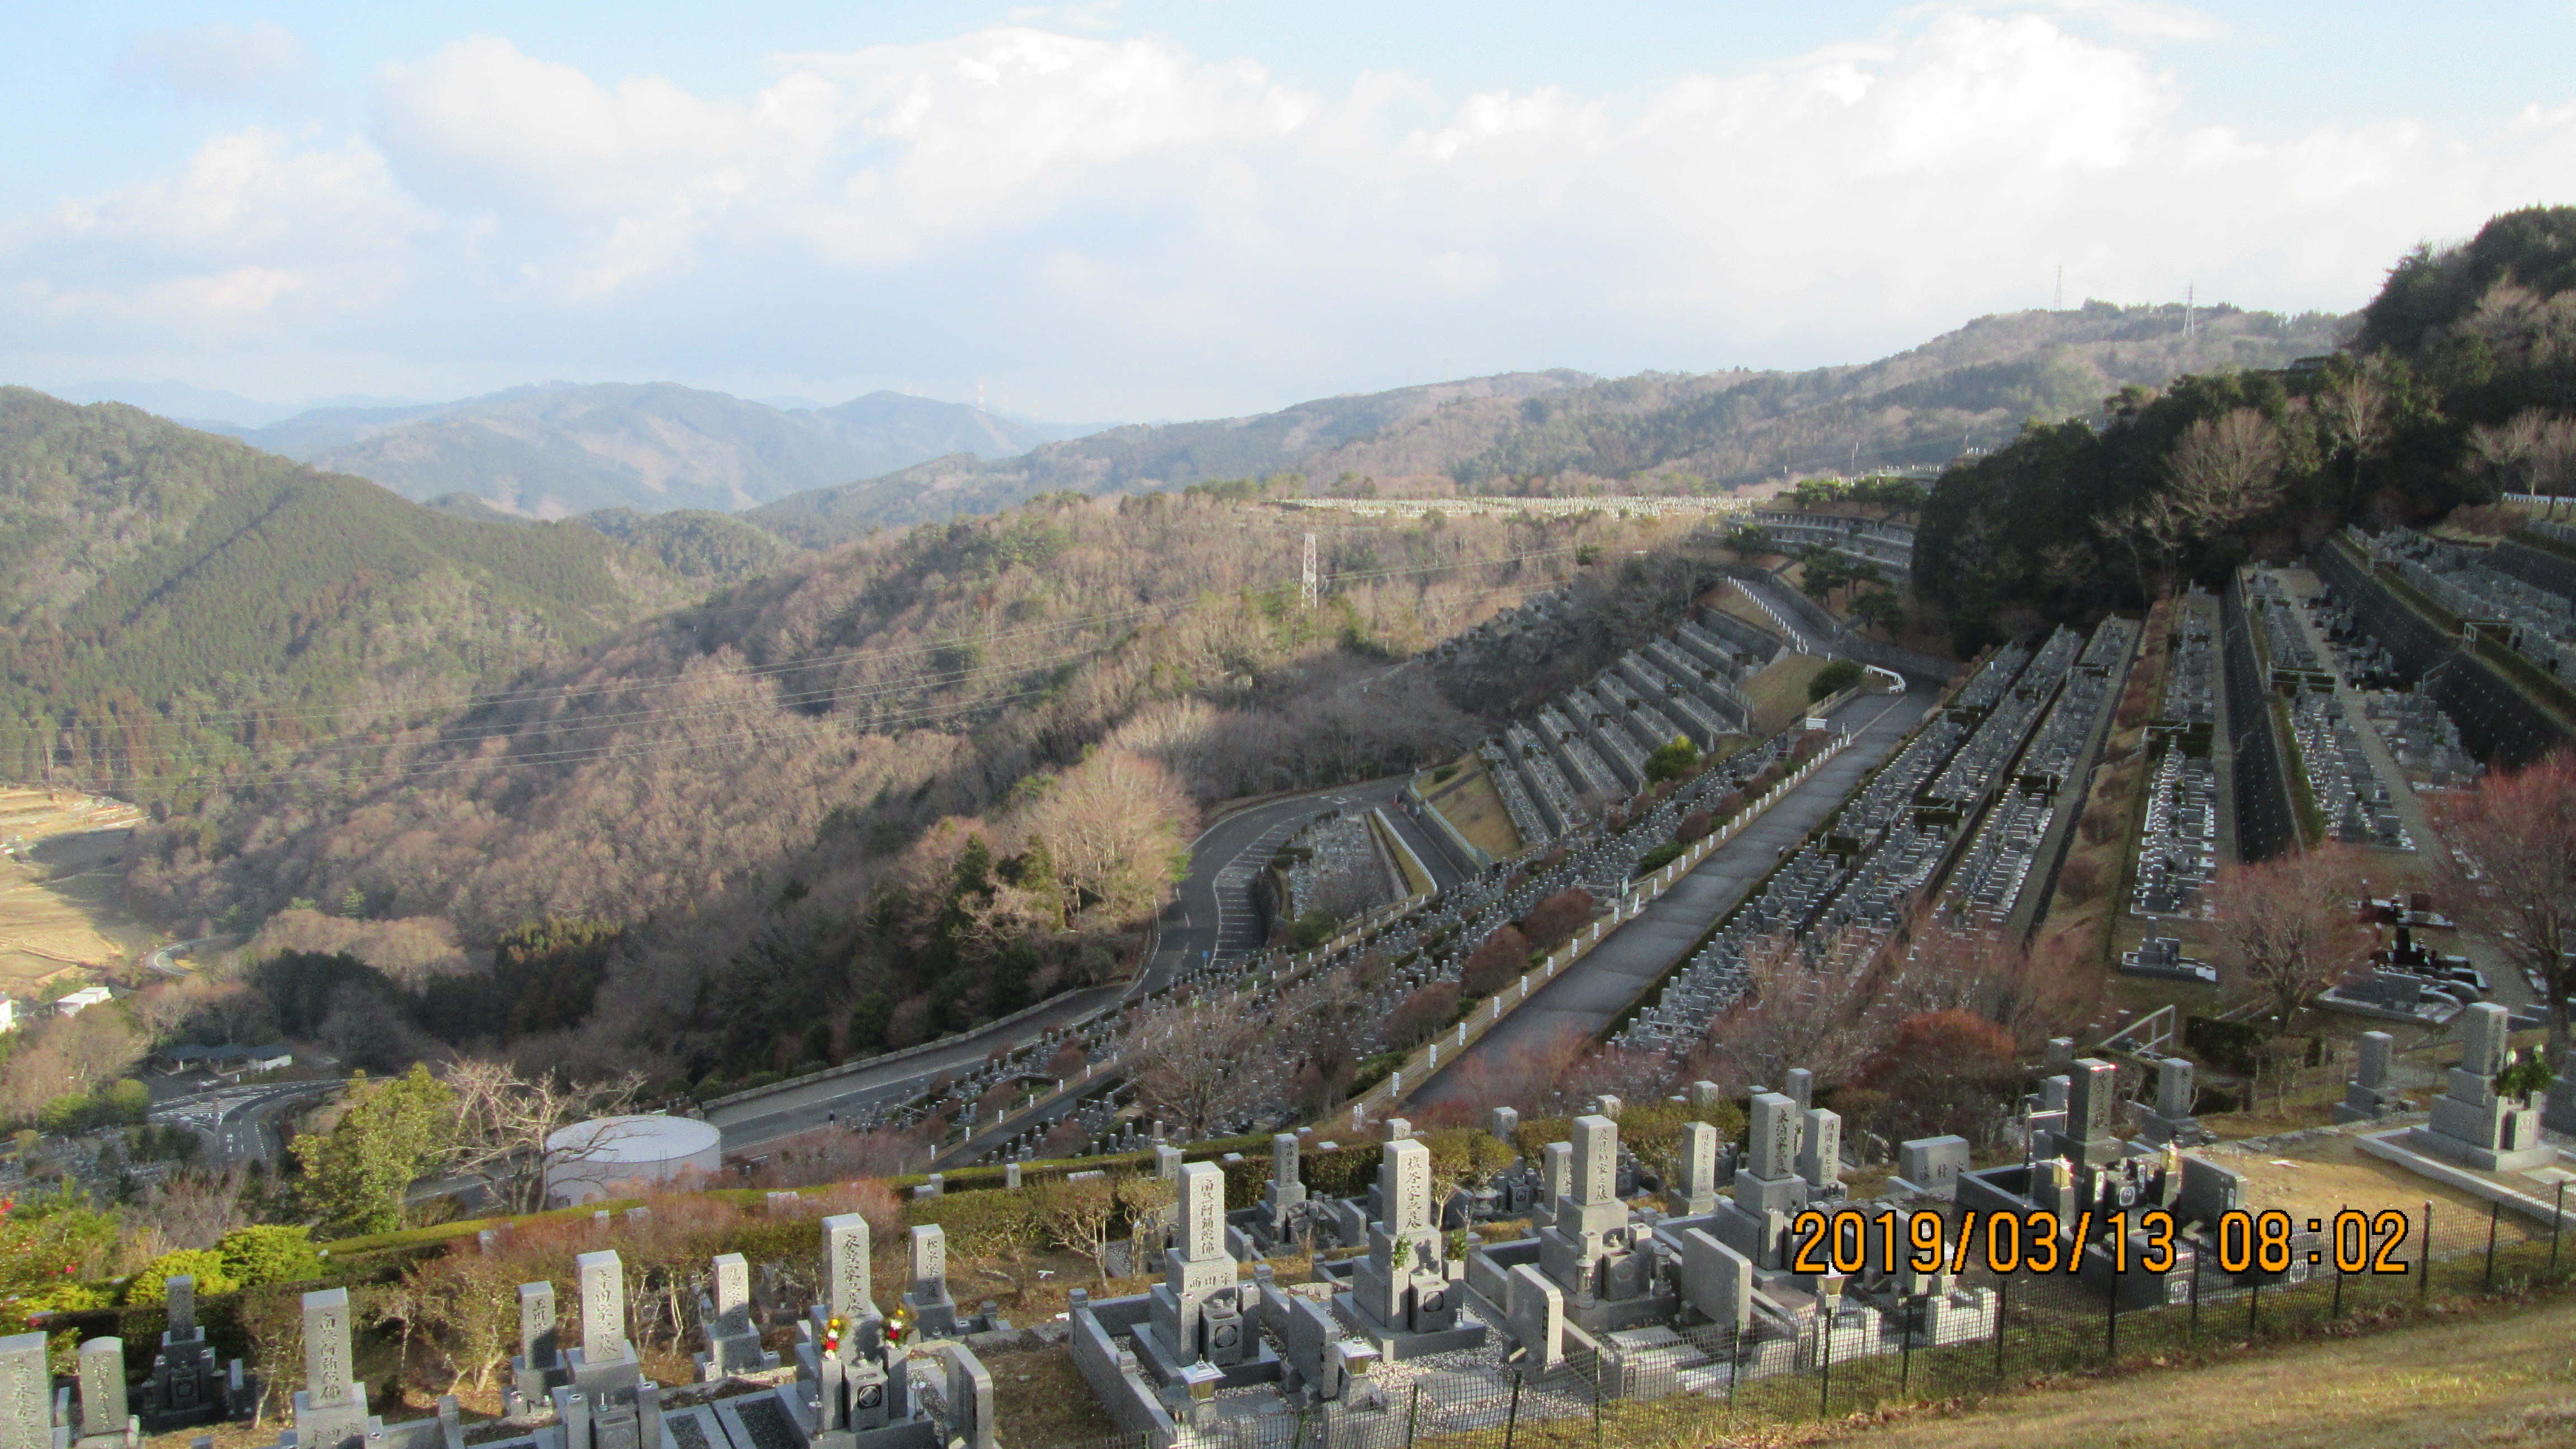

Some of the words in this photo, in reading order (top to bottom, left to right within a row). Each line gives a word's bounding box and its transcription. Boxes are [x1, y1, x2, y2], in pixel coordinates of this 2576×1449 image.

[1405, 1156, 1422, 1229] 塩谷家之墓
